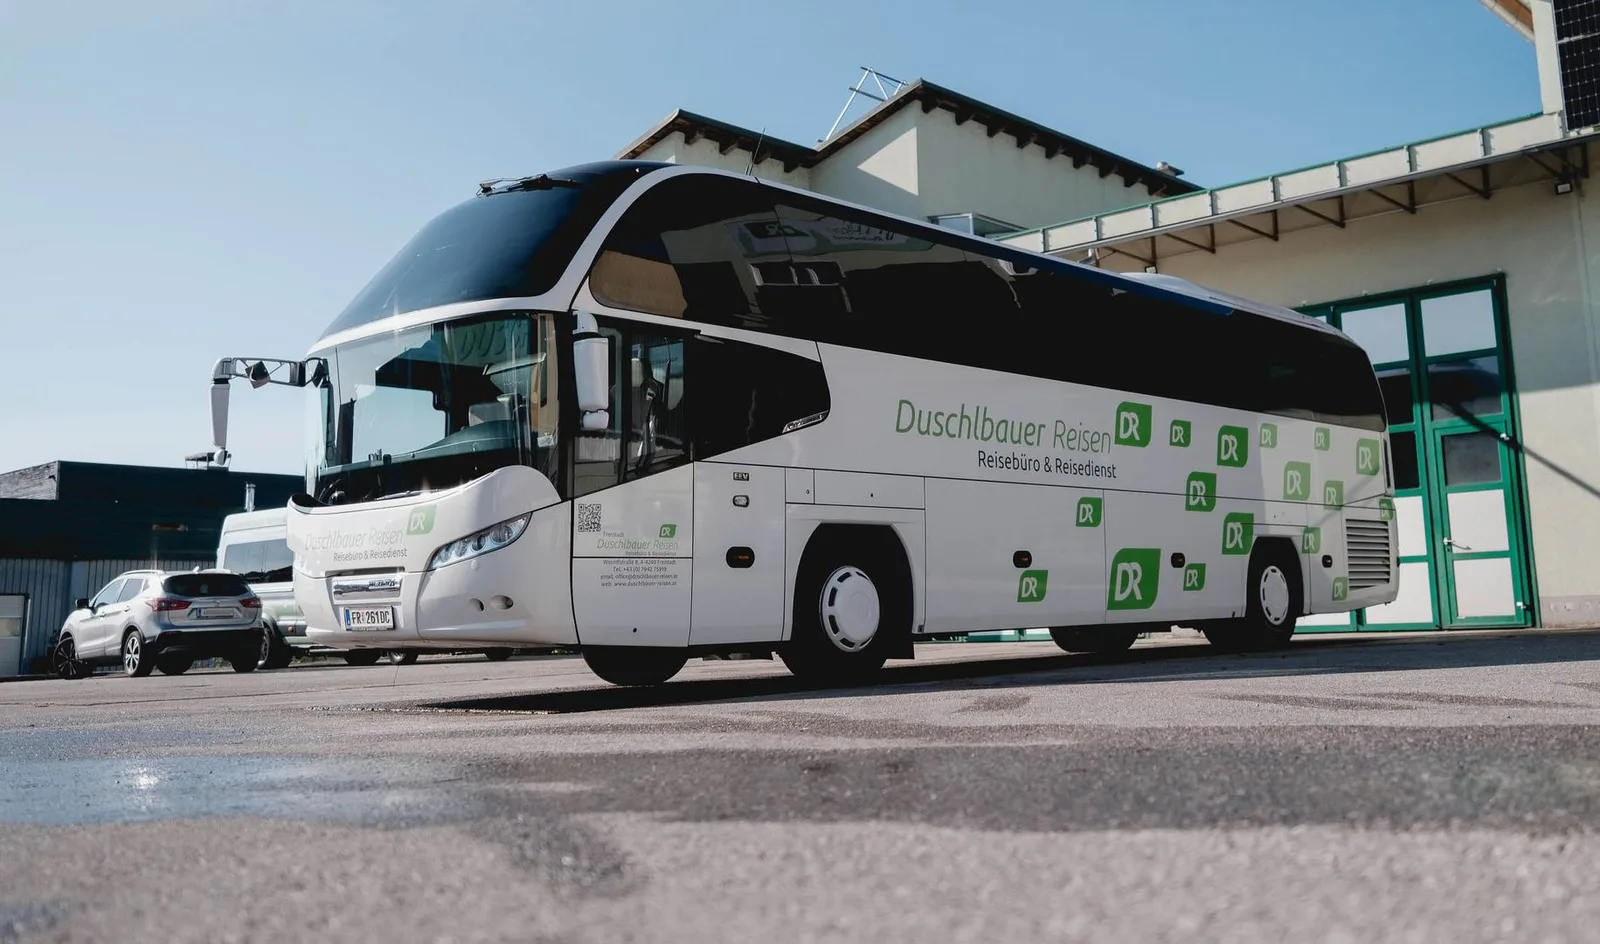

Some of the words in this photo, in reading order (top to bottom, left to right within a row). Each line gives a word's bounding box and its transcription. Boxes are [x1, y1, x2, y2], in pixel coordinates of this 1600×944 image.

[895, 399, 1046, 447] Duschlbauer
[1053, 420, 1112, 453] Reisen
[1119, 411, 1140, 441] DR
[1172, 425, 1185, 443] DR
[1261, 428, 1273, 445] DR
[1315, 432, 1326, 448] DR
[1220, 434, 1239, 462] DR
[977, 450, 1041, 473] Reisebüro
[1043, 457, 1053, 472] &
[1055, 458, 1117, 479] Reisedienst
[1358, 447, 1373, 471] DR
[1286, 470, 1302, 495] DR
[1189, 480, 1207, 506] DR
[1325, 487, 1338, 504] DR
[410, 511, 425, 531] DR
[1078, 503, 1094, 523] DR
[304, 527, 366, 551] Duschlbauer
[369, 525, 405, 547] Reisen
[597, 538, 651, 550] Duschlbauer
[653, 539, 679, 550] Reisen
[1226, 521, 1244, 549] DR
[1304, 532, 1315, 550] DR
[364, 551, 369, 560] &
[369, 548, 408, 560] Reisedienst
[1021, 577, 1037, 598] DR
[1114, 561, 1143, 601] DR
[1186, 569, 1198, 587] DR
[1334, 582, 1343, 597] DR
[351, 611, 362, 625] FR
